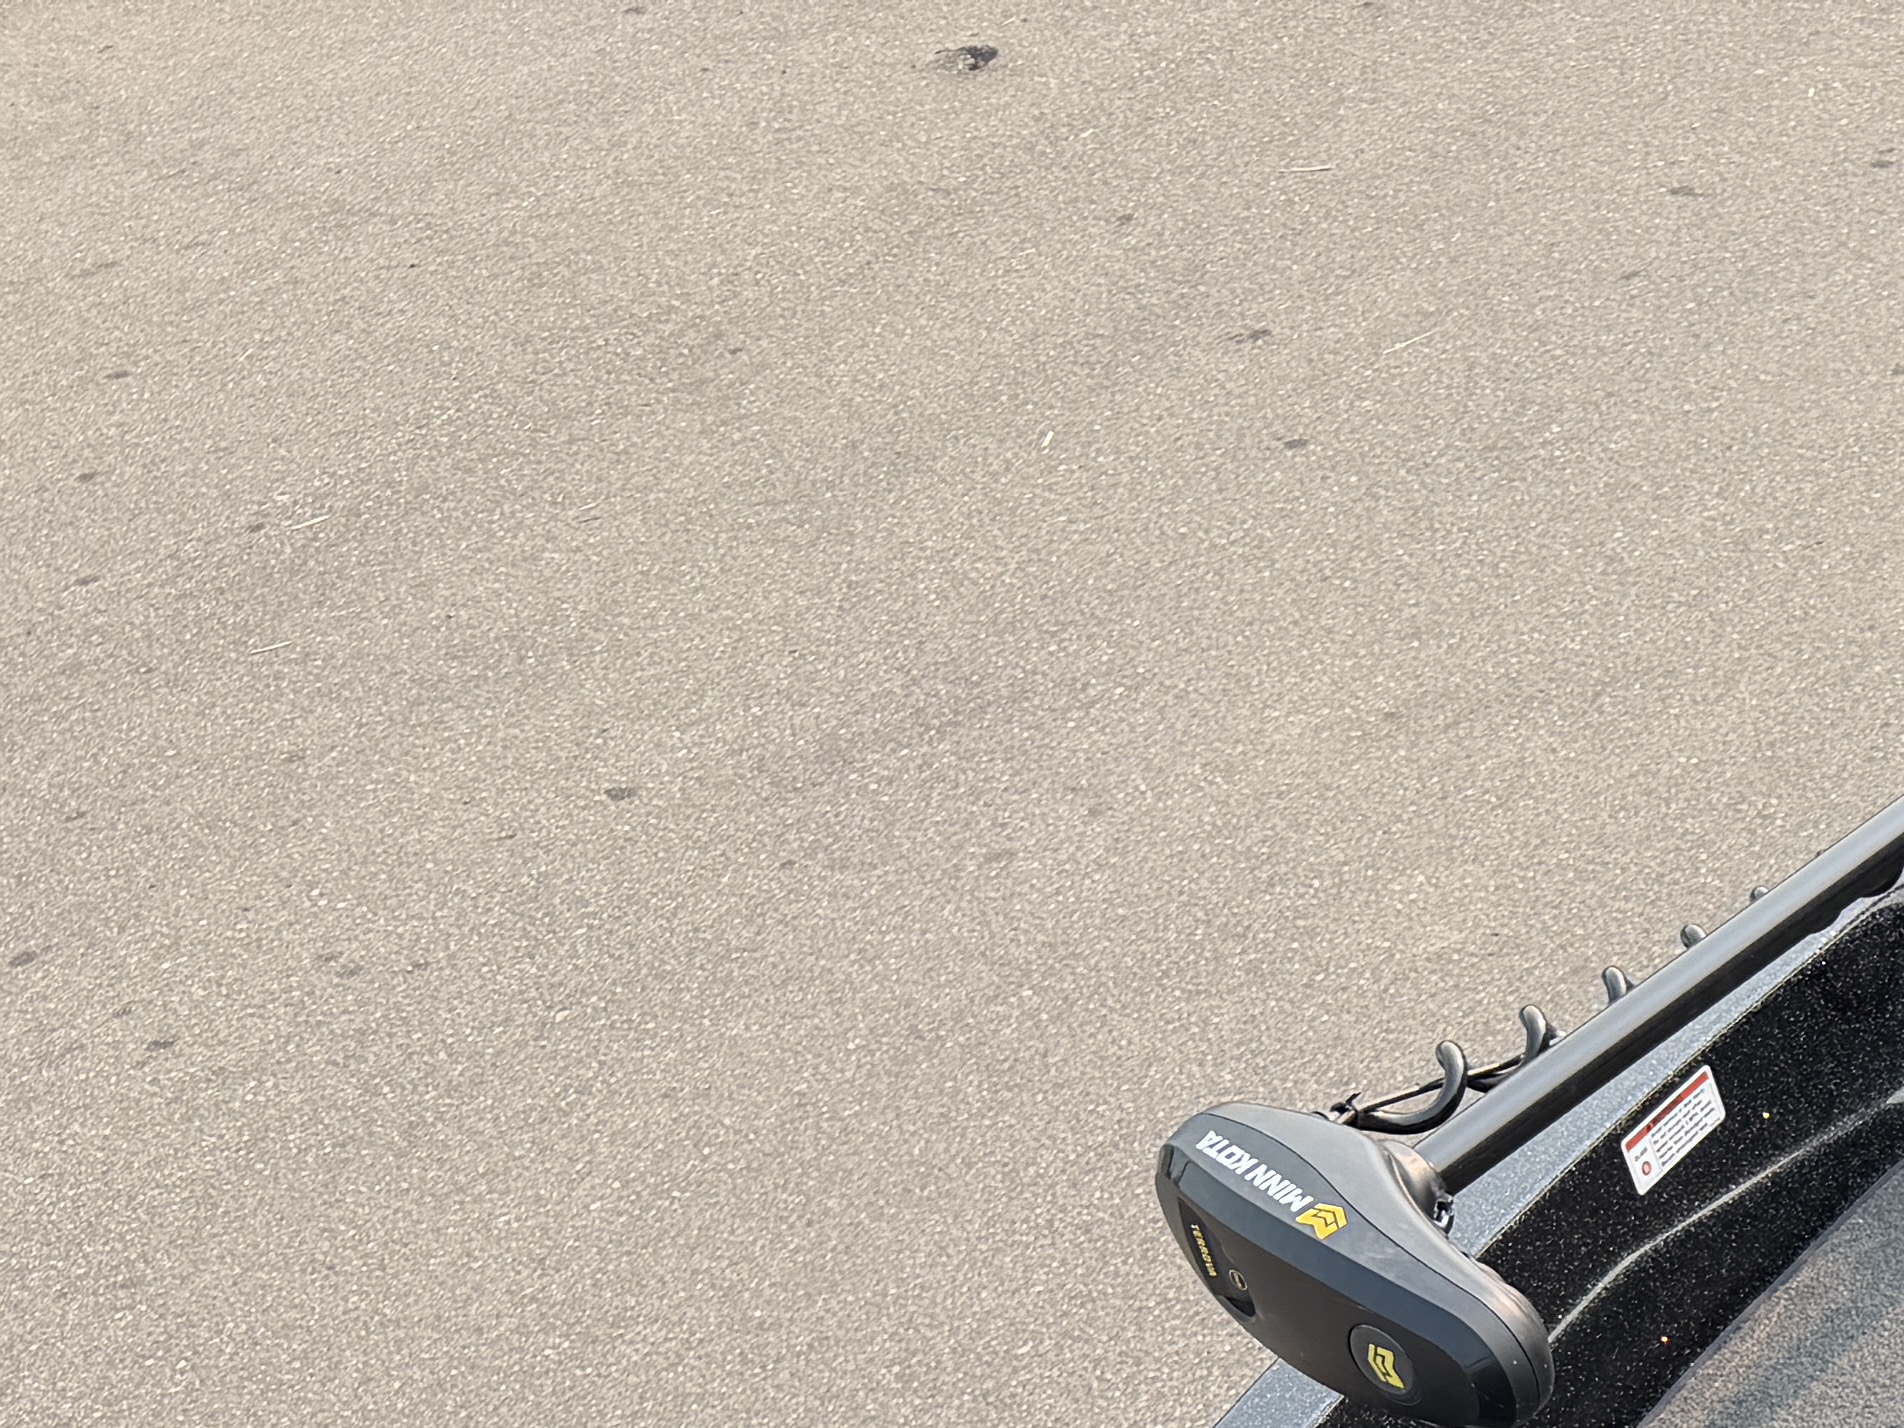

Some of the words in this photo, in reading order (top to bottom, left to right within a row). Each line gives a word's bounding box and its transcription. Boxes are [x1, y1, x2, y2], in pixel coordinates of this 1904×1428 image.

[1195, 1130, 1259, 1176] KOTA
[1244, 1163, 1314, 1213] MINN
[1190, 1223, 1217, 1278] TERROVA
